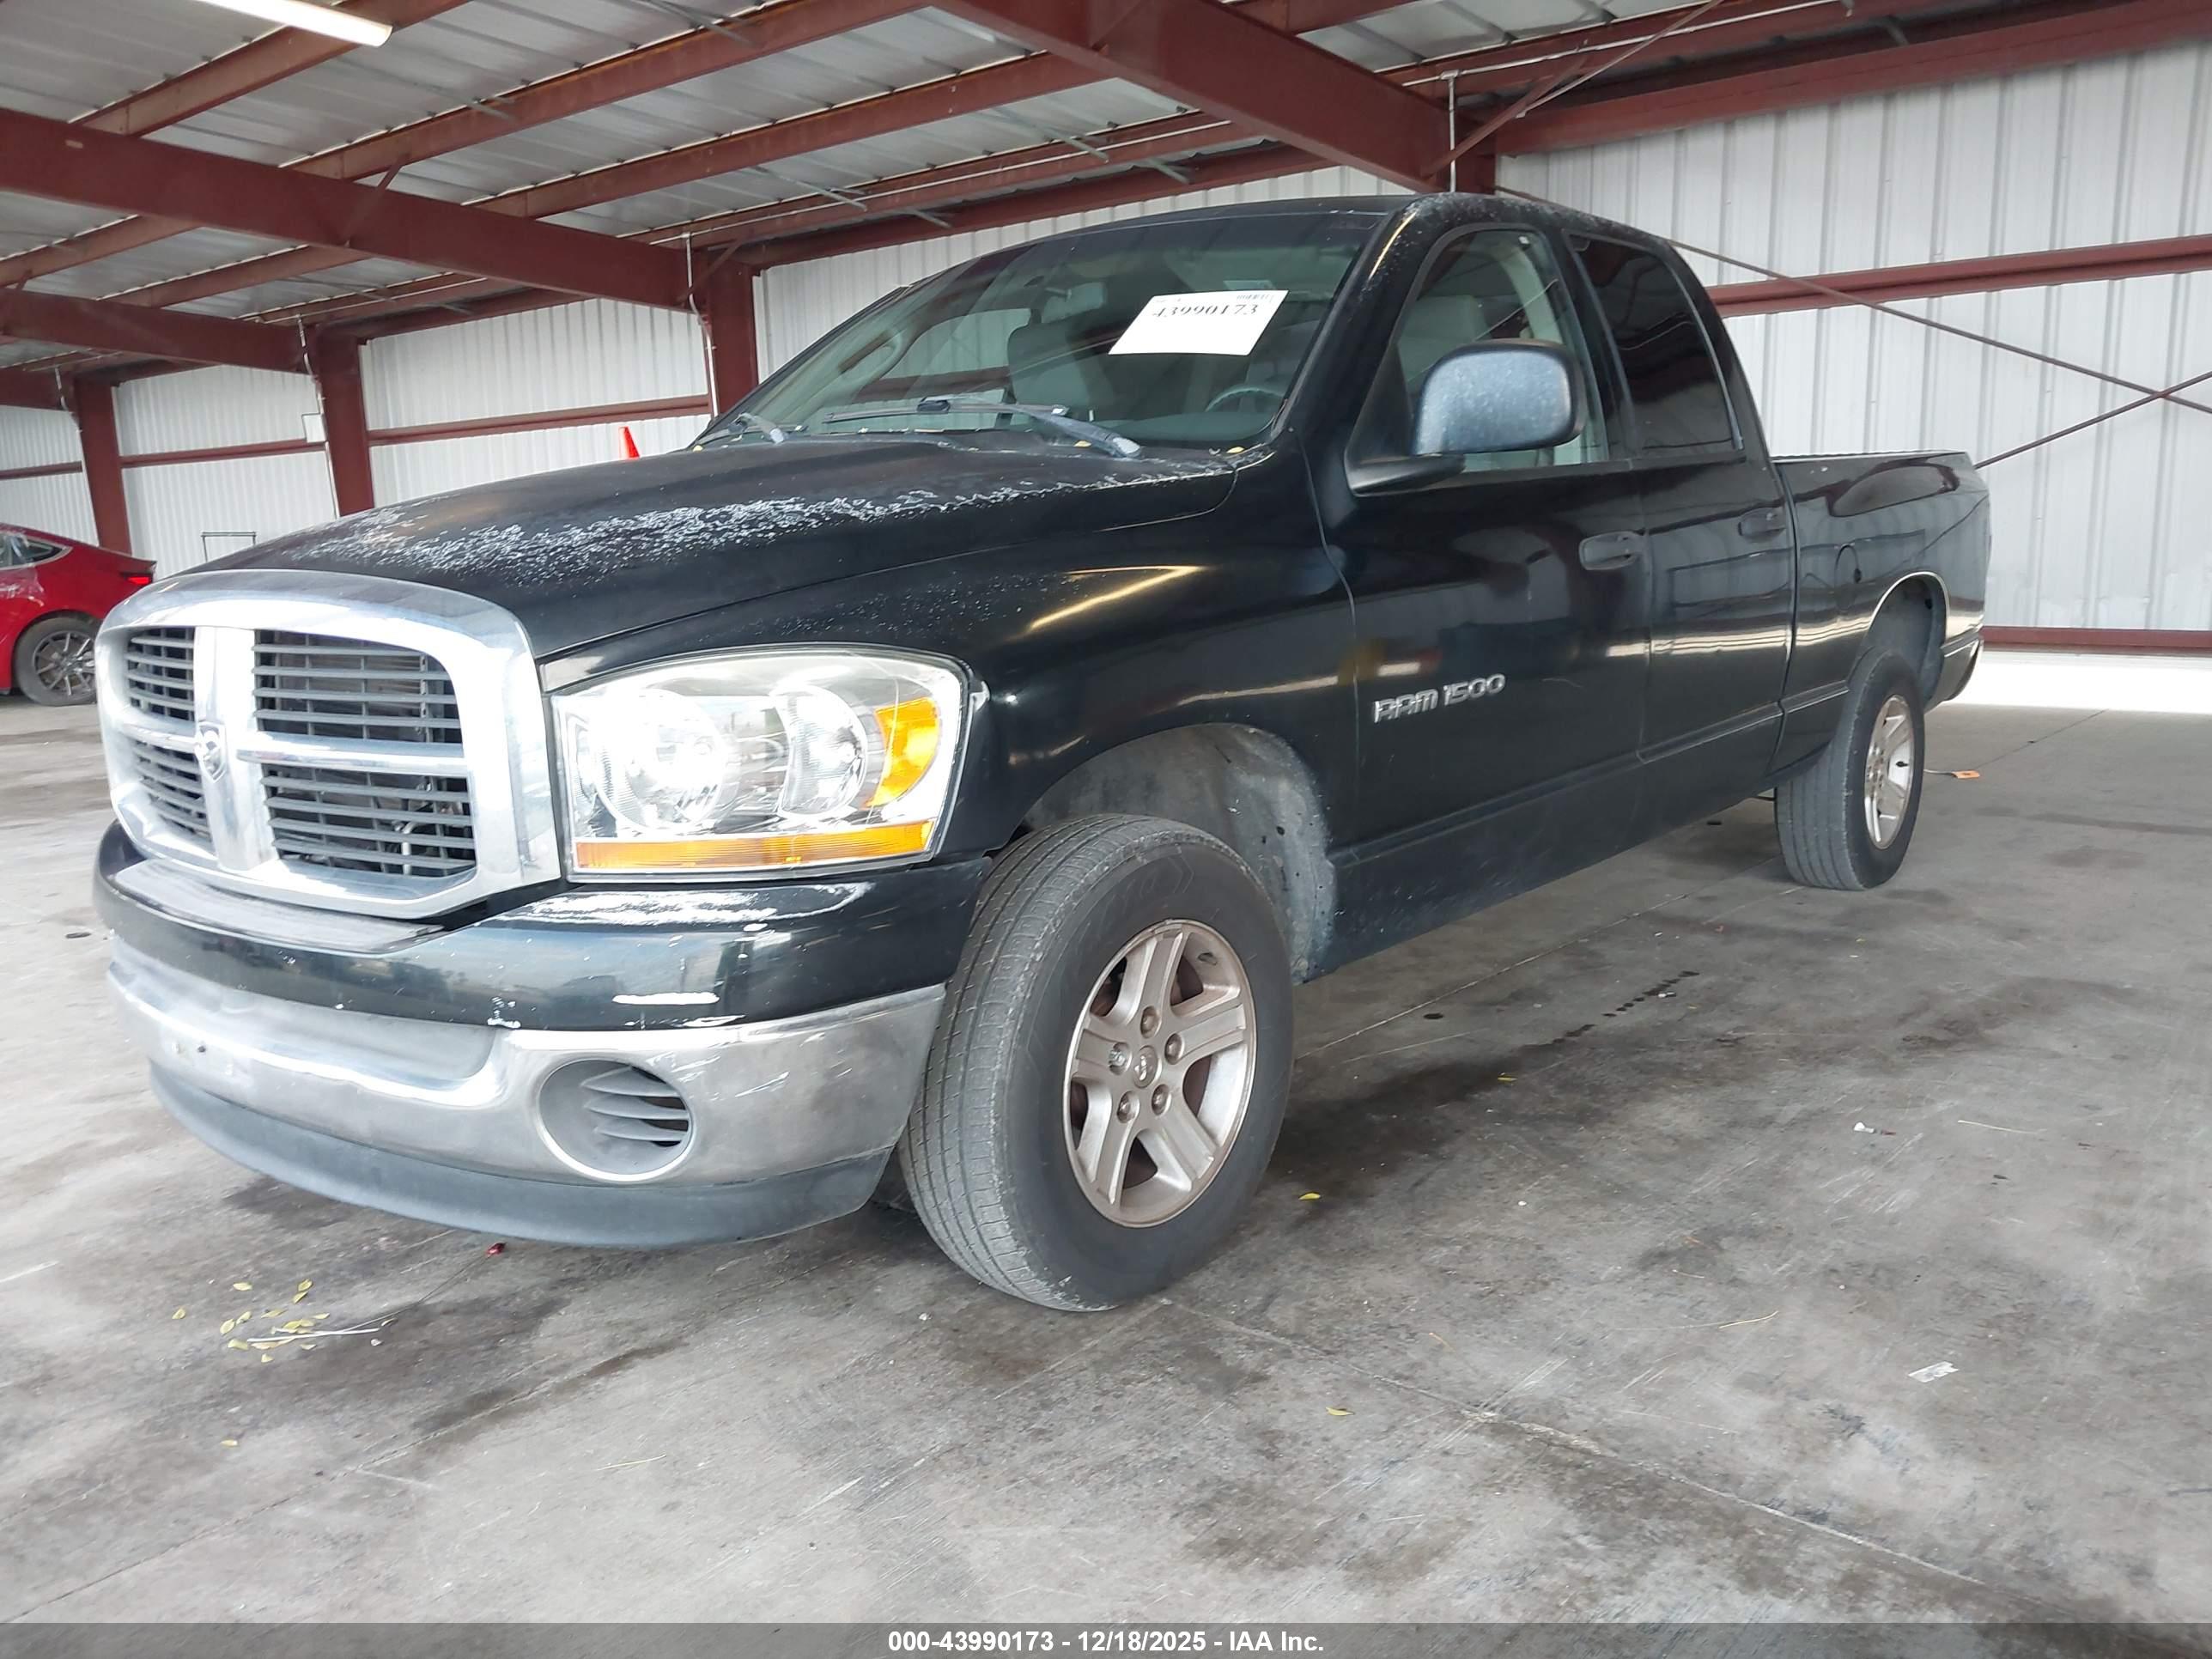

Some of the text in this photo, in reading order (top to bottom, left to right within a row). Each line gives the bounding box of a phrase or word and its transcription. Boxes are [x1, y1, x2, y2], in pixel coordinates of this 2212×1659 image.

[1152, 303, 1259, 319] 43990173
[1374, 673, 1505, 723] RAM 1500
